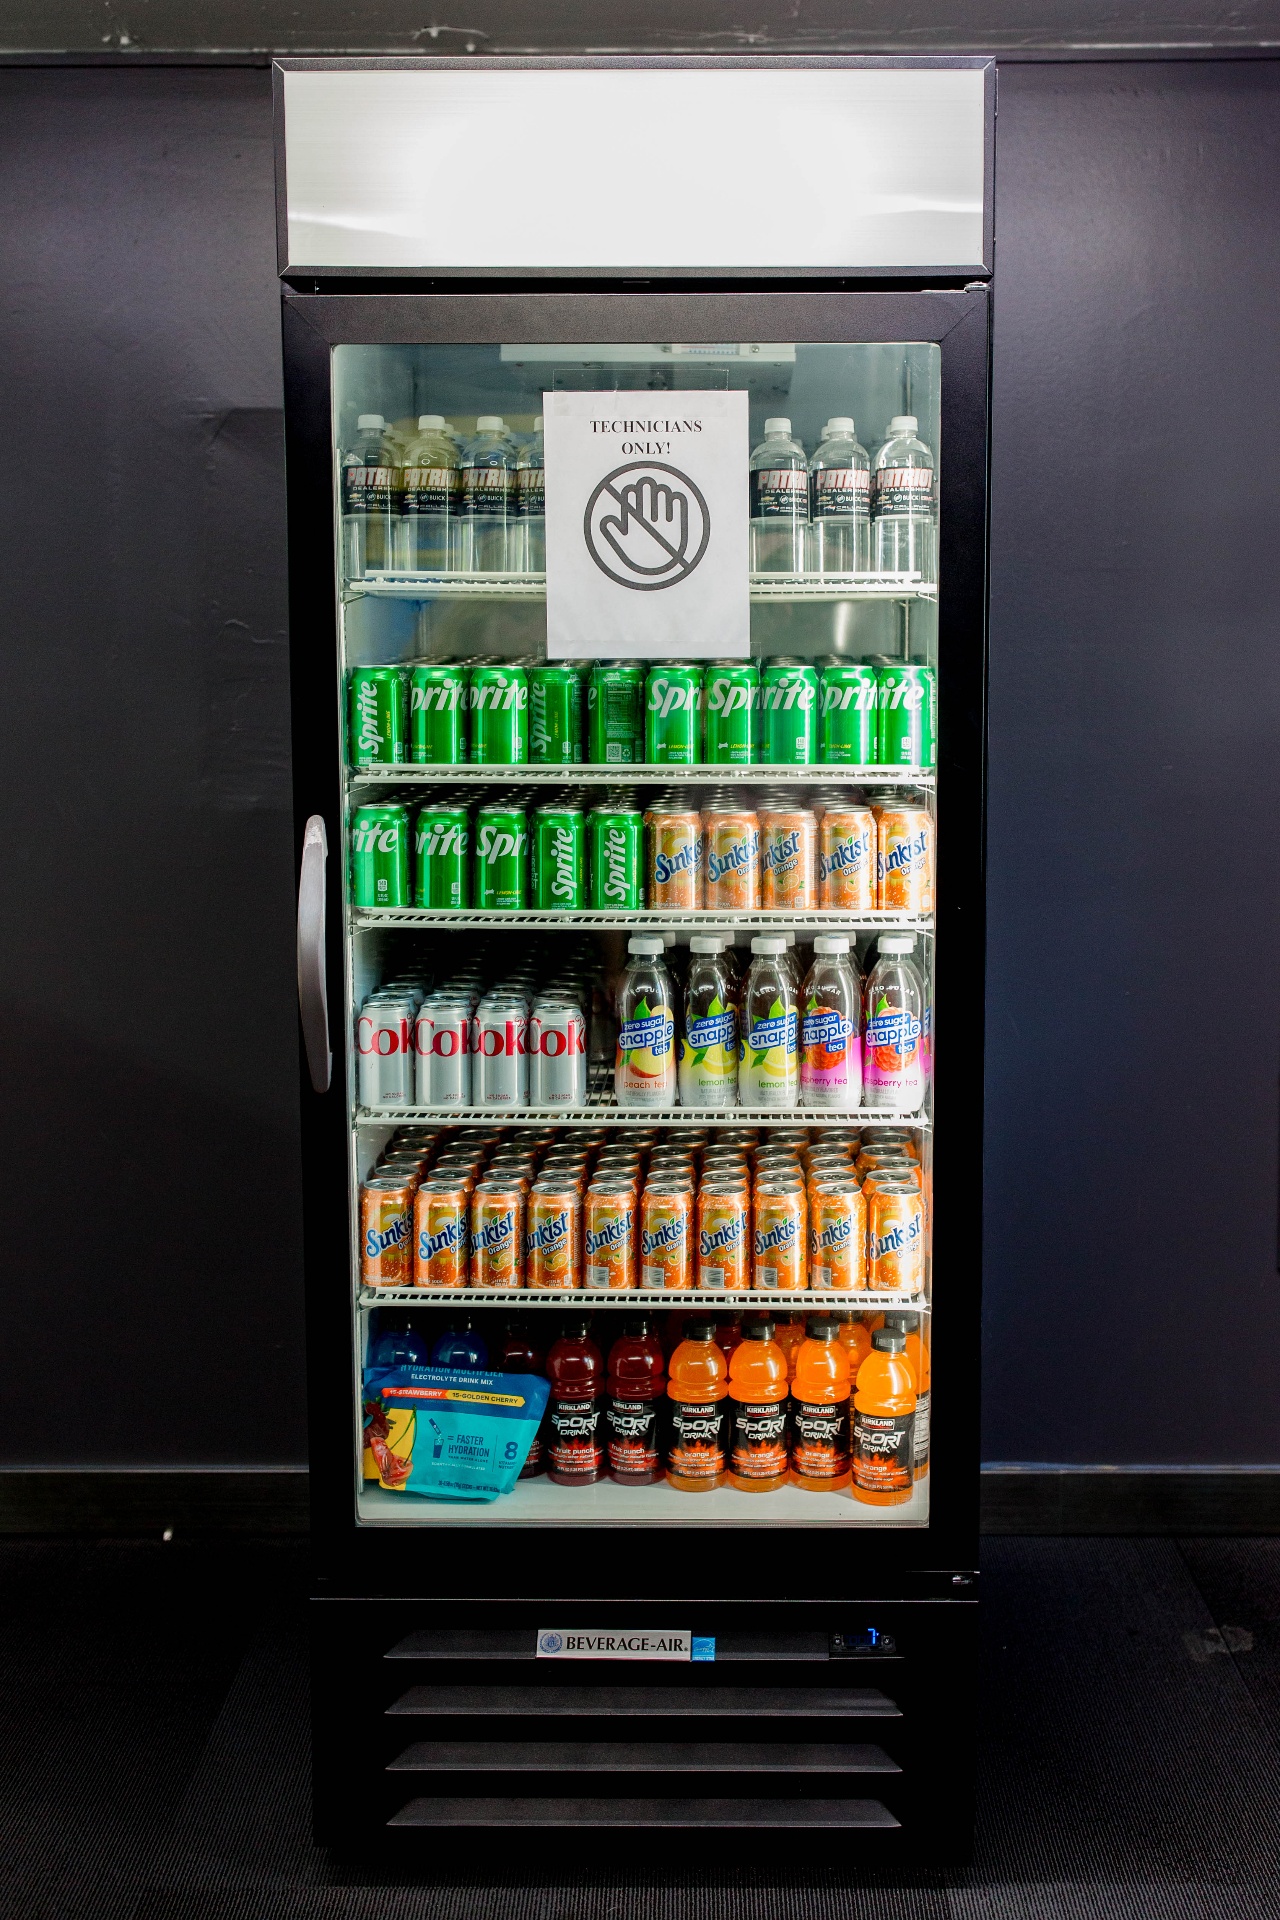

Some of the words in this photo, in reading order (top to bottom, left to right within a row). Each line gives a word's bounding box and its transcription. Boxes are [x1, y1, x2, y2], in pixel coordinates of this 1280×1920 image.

[590, 420, 702, 433] TECHNICIANS
[621, 442, 671, 455] ONLY!
[357, 680, 384, 755] Sprite
[529, 681, 552, 754] Sprite
[708, 831, 760, 883] Sunkist
[820, 831, 869, 881] Sunkist
[878, 831, 928, 881] Sunkist
[551, 828, 577, 900] Sprite
[603, 828, 631, 901] Sprite
[773, 859, 798, 876] Orange
[624, 1022, 640, 1031] zero
[641, 1016, 664, 1028] sugar
[696, 1020, 714, 1028] zero
[757, 1021, 775, 1029] zero
[815, 1014, 837, 1025] sugar
[868, 1020, 884, 1028] zero
[884, 1014, 908, 1026] sugar
[529, 1017, 587, 1057] Cok
[620, 1021, 674, 1046] snapple
[867, 1021, 919, 1043] snapple
[655, 1044, 668, 1055] tea
[828, 1042, 843, 1052] tea
[898, 1042, 913, 1053] tea
[699, 1078, 724, 1086] lemon
[758, 1080, 785, 1088] lemon
[585, 1211, 632, 1255] Sunkist
[642, 1212, 688, 1256] Sunkist
[700, 1211, 747, 1257] Sunkist
[488, 1238, 513, 1255] Orange
[542, 1238, 567, 1256] Orange
[411, 1373, 457, 1382] ELECTROLYTE
[452, 1392, 489, 1401] 15-GOLDEN
[491, 1396, 519, 1404] CHERRY
[558, 1403, 590, 1411] KIRKLAND
[612, 1401, 642, 1411] KIRKLAND
[681, 1406, 714, 1414] KIRKLAND
[746, 1405, 778, 1414] KIRKLAND
[802, 1405, 834, 1414] KIRKLAND
[551, 1411, 600, 1431] SPORT
[606, 1410, 656, 1431] SPORT
[672, 1414, 724, 1434] SPORT
[735, 1414, 787, 1434] SPORT
[795, 1415, 845, 1435] SPORT
[861, 1417, 894, 1427] KIRKLAND
[560, 1428, 590, 1436] DRINK
[615, 1426, 640, 1436] DRINK
[682, 1431, 712, 1439] DRINK
[748, 1431, 776, 1440] DRINK
[803, 1431, 834, 1440] DRINK
[853, 1426, 905, 1449] SPORT
[457, 1434, 484, 1446] FASTER
[448, 1444, 490, 1457] HYDRATION
[504, 1441, 518, 1460] 8
[611, 1444, 622, 1453] fruit
[862, 1443, 891, 1453] DRINK
[805, 1451, 830, 1459] orange
[863, 1463, 887, 1472] orange
